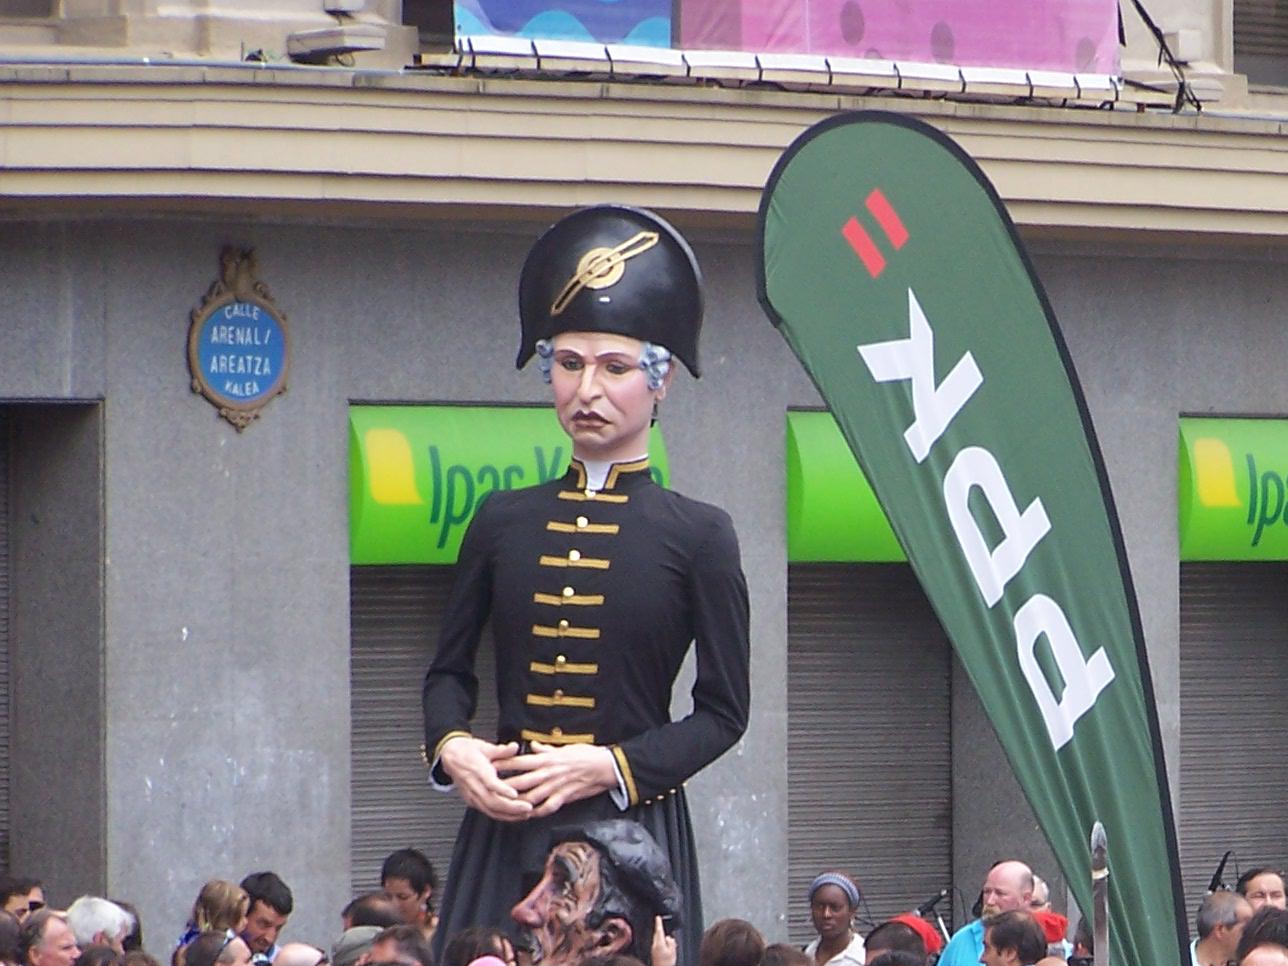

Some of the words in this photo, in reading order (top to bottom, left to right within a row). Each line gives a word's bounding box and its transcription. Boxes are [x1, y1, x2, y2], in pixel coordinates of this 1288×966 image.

[225, 303, 260, 321] CALLE
[210, 355, 271, 375] AREATZA
[225, 381, 260, 396] KALEA
